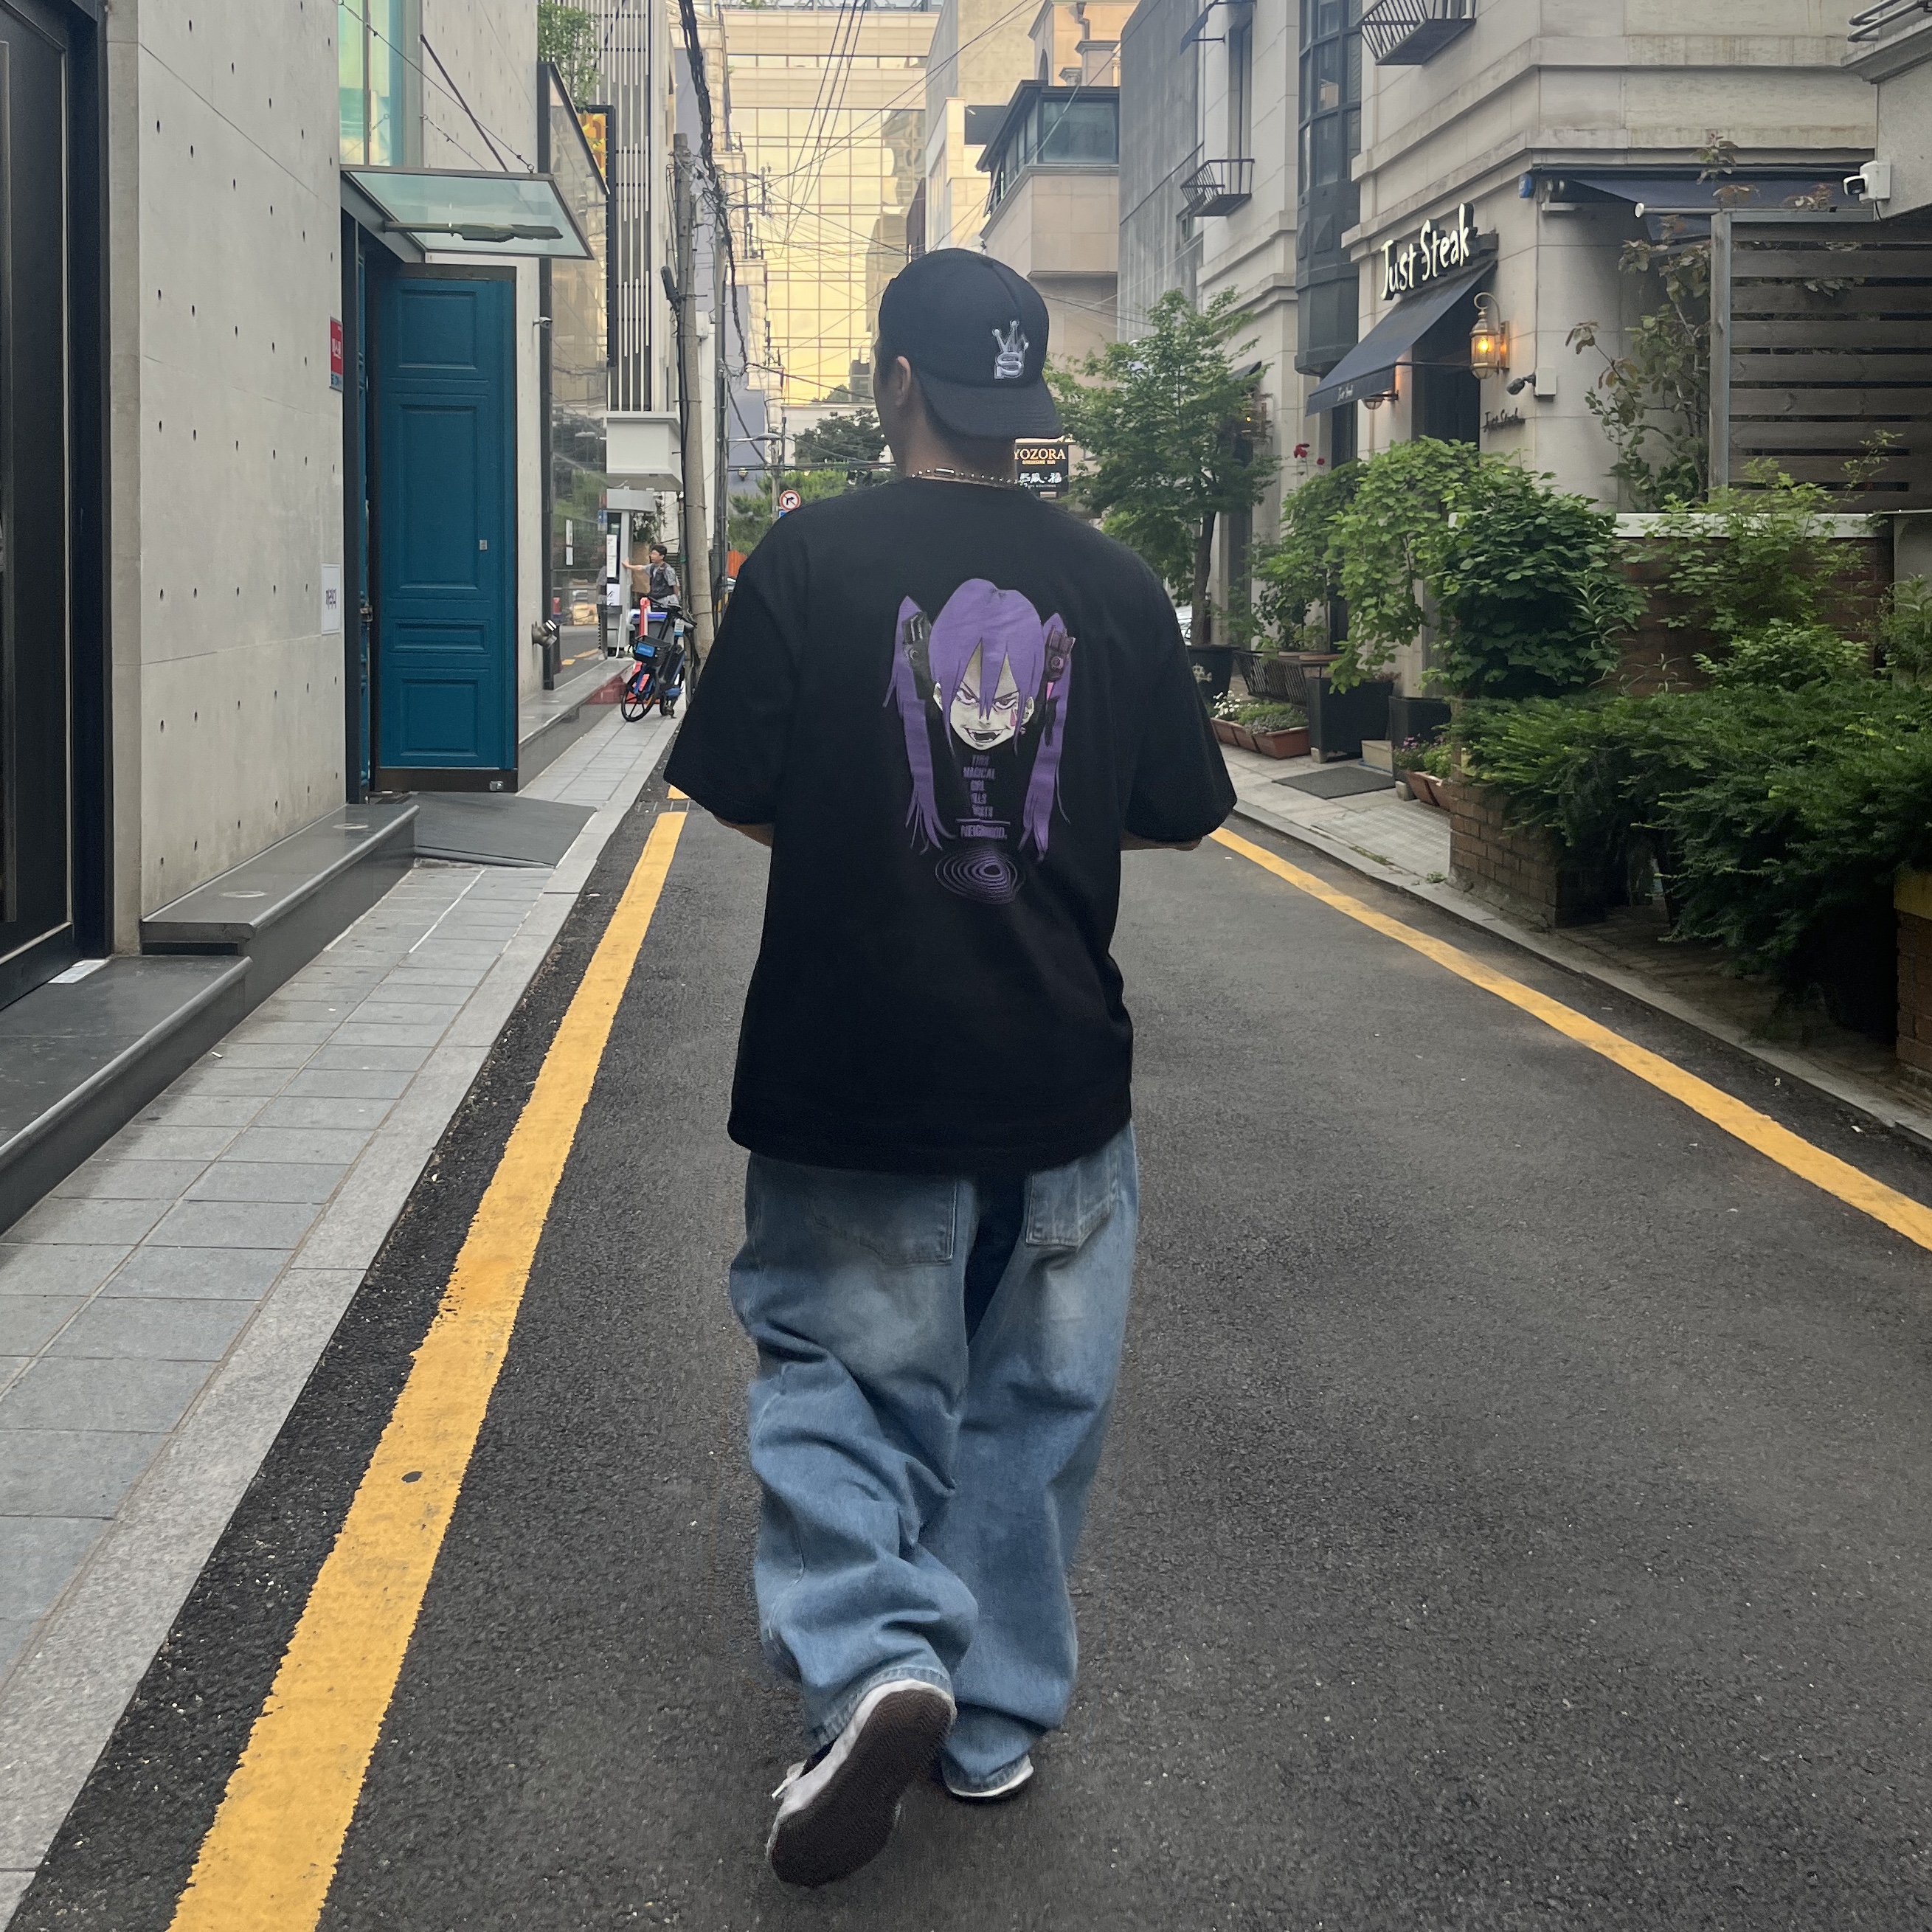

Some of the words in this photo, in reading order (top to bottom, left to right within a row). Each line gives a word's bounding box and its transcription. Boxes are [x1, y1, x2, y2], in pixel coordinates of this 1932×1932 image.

[1380, 239, 1416, 300] Just
[1420, 203, 1470, 282] Steak
[1014, 448, 1066, 460] YOZORA
